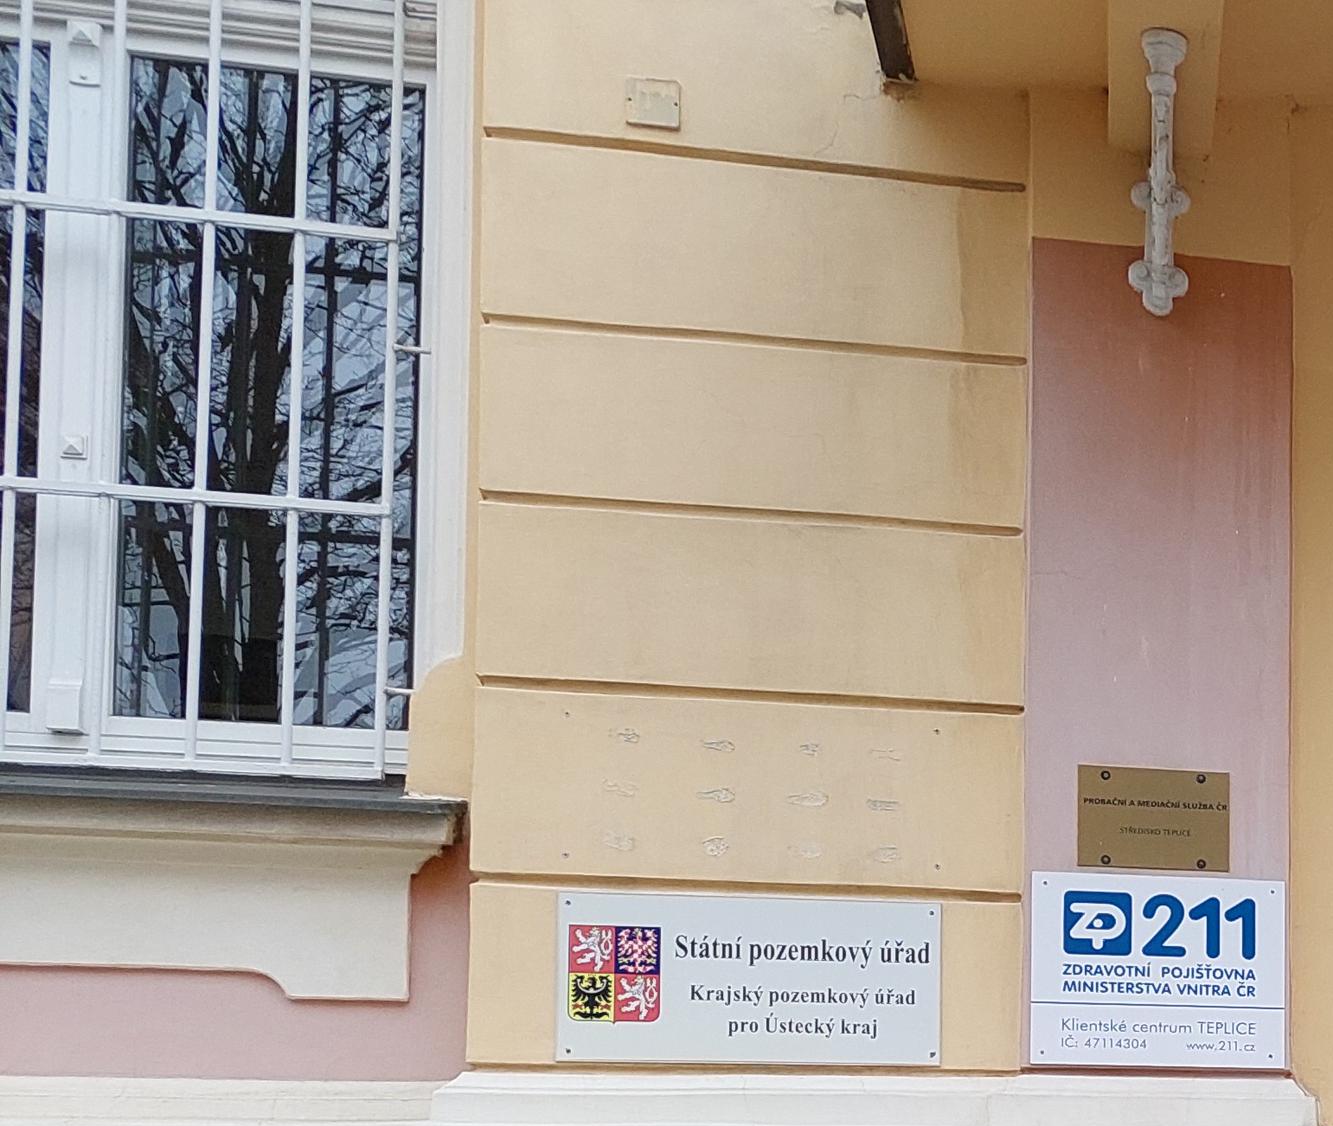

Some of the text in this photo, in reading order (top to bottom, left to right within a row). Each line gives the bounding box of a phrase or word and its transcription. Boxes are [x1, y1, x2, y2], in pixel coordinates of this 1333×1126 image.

[1083, 797, 1127, 807] PROBAČNÍ
[1137, 799, 1181, 809] MEDIAČNÍ
[1183, 802, 1214, 811] SLUŽBA
[1216, 803, 1228, 812] ČR
[1141, 894, 1256, 960] 211
[674, 934, 930, 969] Státní pozemkový úřad
[1062, 962, 1256, 981] ZDRAVOTNÍ POJIŠŤOVNA
[690, 984, 916, 1008] Krajský pozemkový úřad
[1062, 980, 1256, 997] MINISTERSTVA VNITRA ČR
[728, 1012, 878, 1040] pro Ústecký kraj
[1061, 1018, 1256, 1036] Klientské centrum TEPLICE
[1061, 1035, 1147, 1050] IČ: 47114304
[1186, 1040, 1256, 1052] www.211.cz
